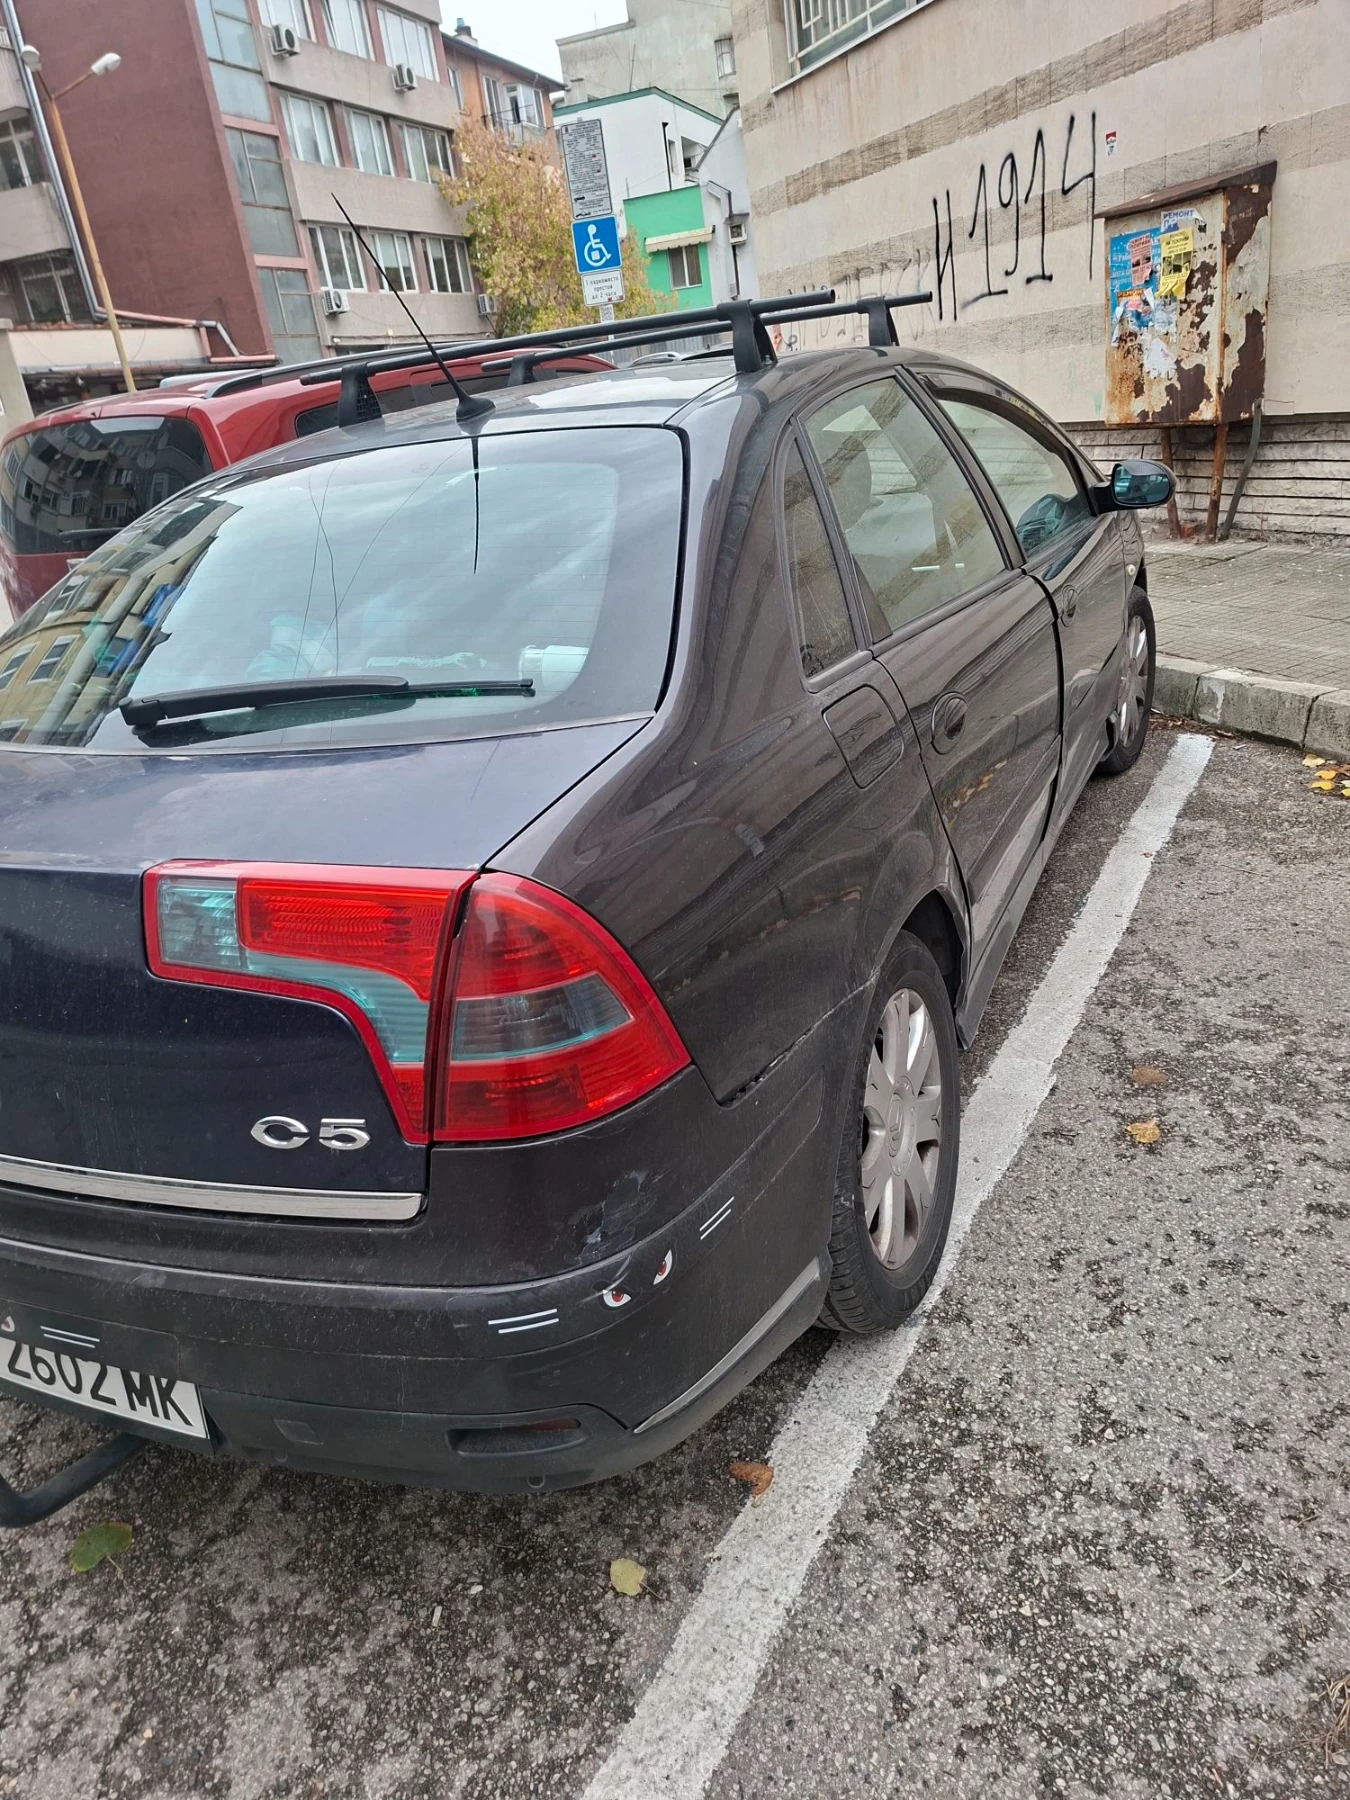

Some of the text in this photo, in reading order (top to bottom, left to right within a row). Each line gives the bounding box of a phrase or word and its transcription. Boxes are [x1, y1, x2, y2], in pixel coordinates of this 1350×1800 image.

[960, 111, 1097, 310] 1914
[1163, 209, 1194, 219] РЕМОНТ
[1117, 288, 1144, 298] РЕМОН
[250, 1115, 372, 1151] C5
[6, 1341, 194, 1428] 2602 MK
